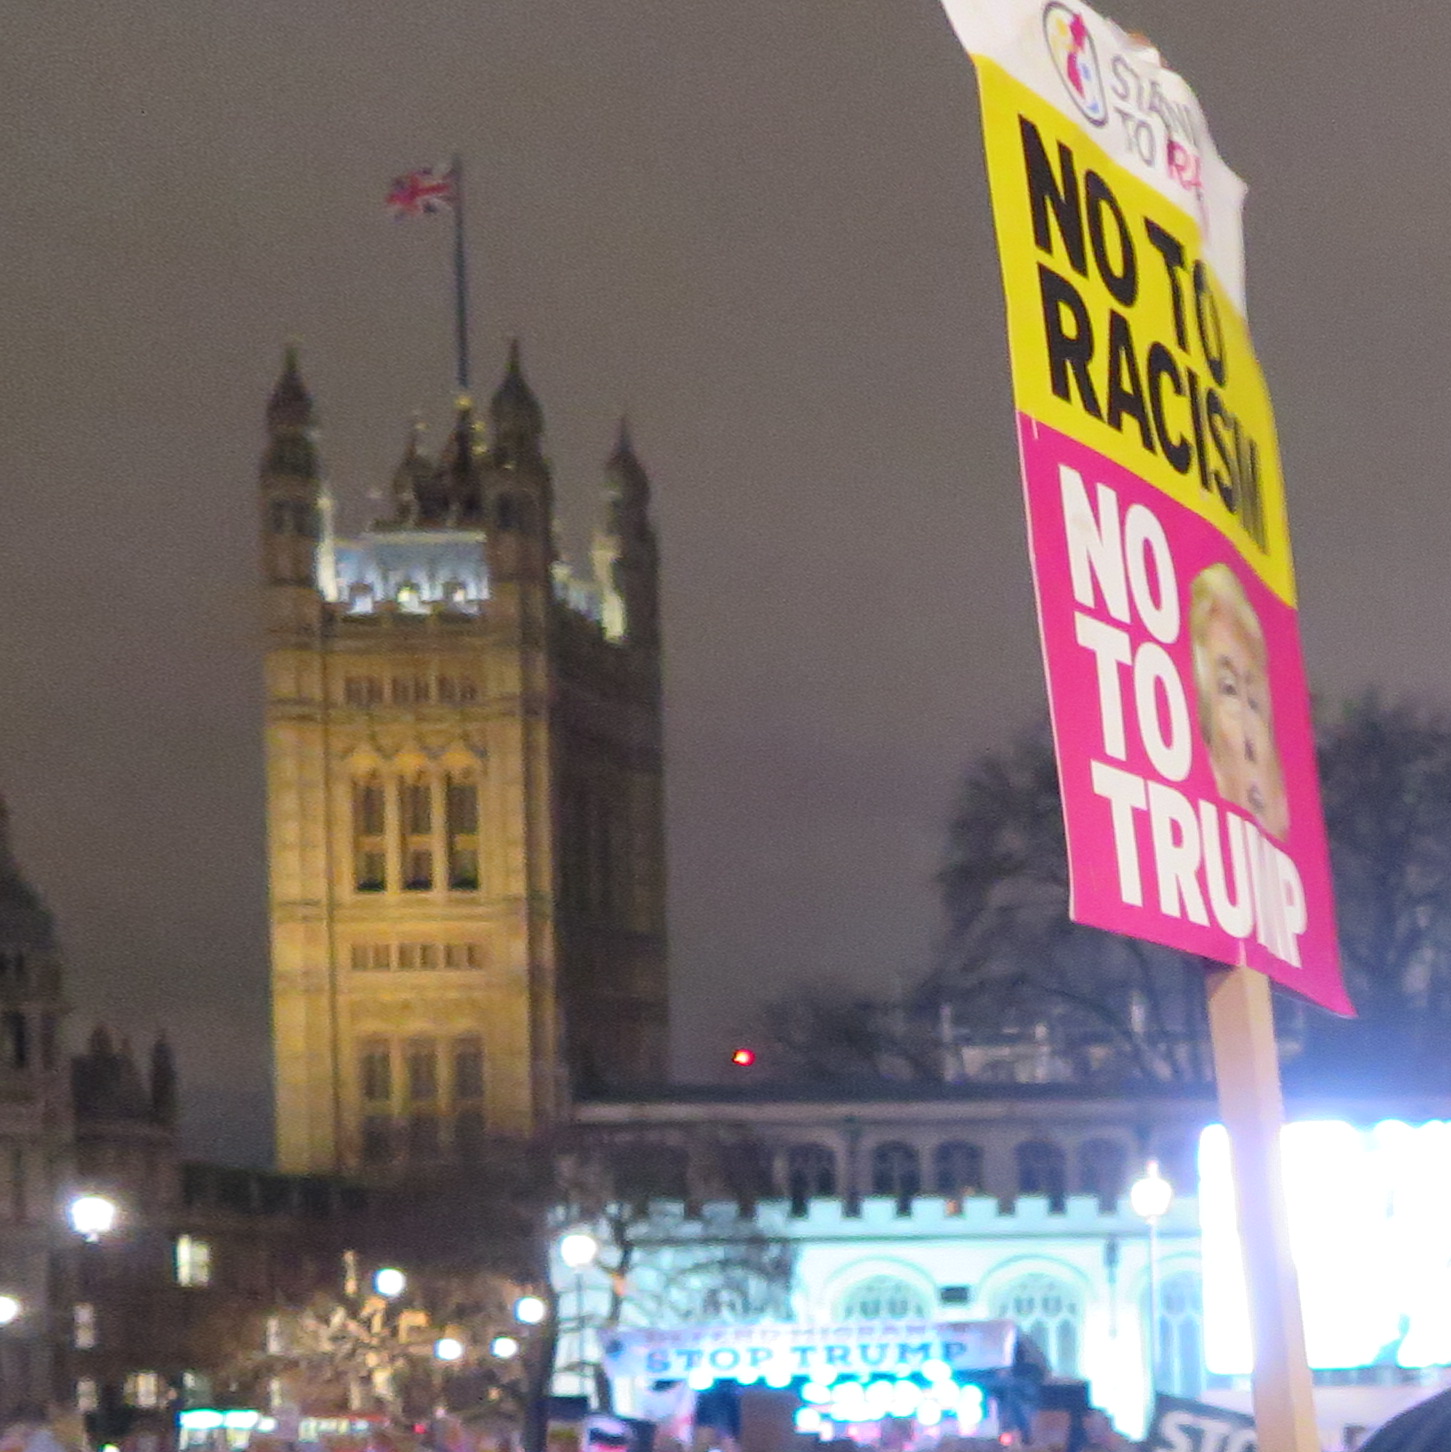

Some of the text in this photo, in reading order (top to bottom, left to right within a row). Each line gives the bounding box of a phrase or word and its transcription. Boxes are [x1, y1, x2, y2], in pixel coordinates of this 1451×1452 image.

[1113, 105, 1156, 168] TO
[1017, 113, 1138, 307] NO
[1145, 216, 1227, 388] TO
[1037, 262, 1270, 555] RACISM
[1058, 463, 1181, 645] NO
[1075, 611, 1193, 782] TO
[1090, 760, 1308, 970] TRUMP
[645, 1341, 967, 1374] STOP TRUMP
